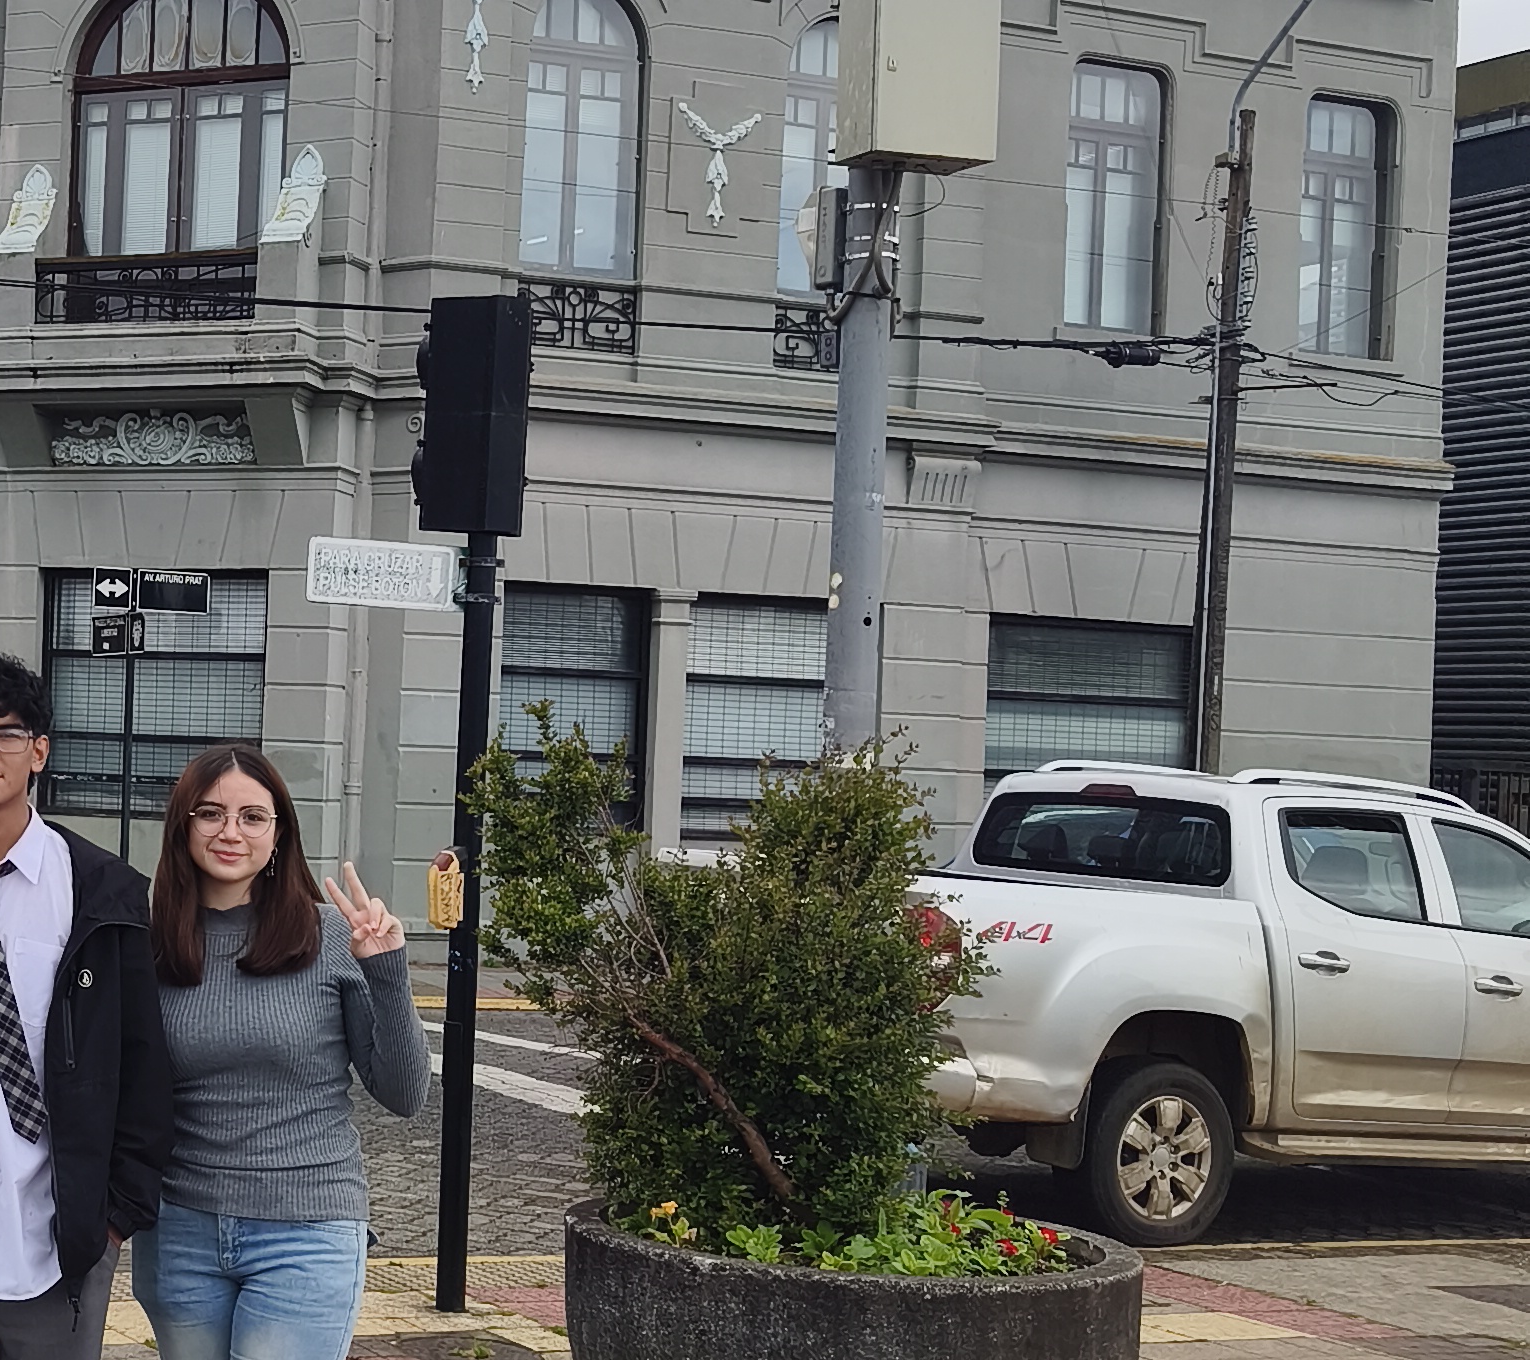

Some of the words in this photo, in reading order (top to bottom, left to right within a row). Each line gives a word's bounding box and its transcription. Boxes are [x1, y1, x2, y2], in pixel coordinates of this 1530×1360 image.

[320, 548, 361, 569] PARA
[365, 551, 423, 574] CRUZAR
[156, 574, 183, 584] ARTURO
[185, 575, 203, 585] PRAT
[320, 571, 369, 594] PULSE
[977, 921, 1054, 944] 4x4
